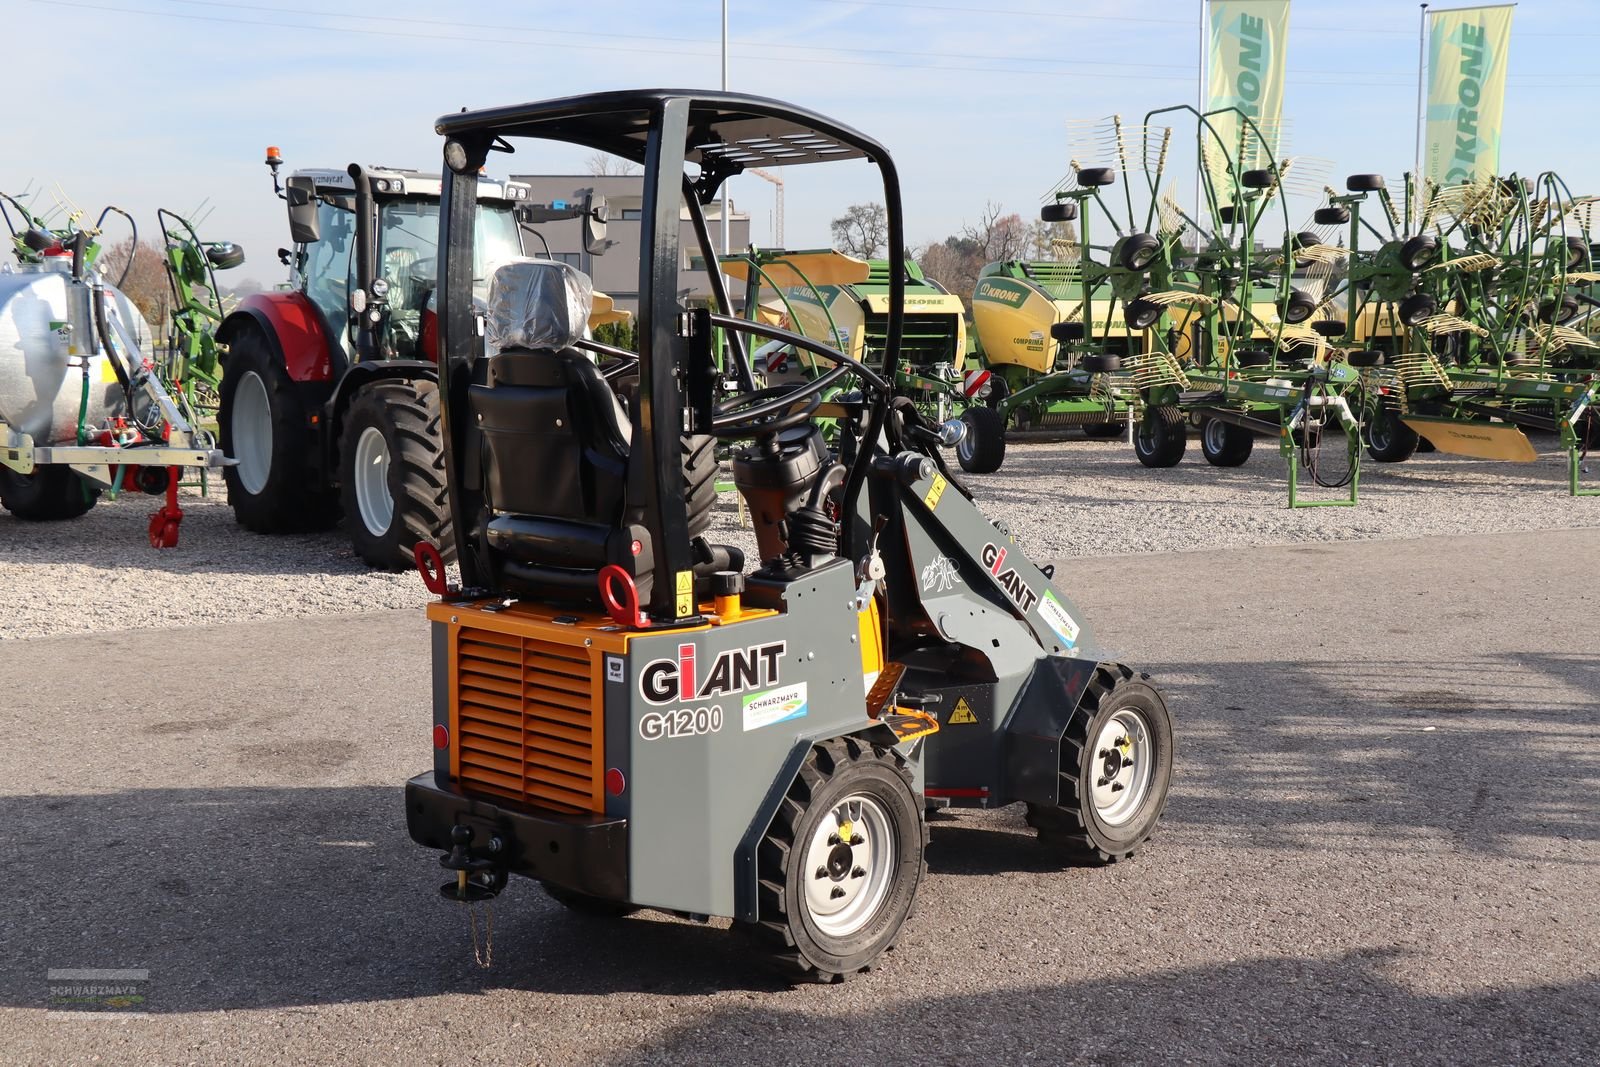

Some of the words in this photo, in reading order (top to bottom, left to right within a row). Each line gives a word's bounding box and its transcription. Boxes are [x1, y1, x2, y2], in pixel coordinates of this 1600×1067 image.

[1455, 22, 1485, 164] KRONE
[988, 288, 1021, 302] KRONE
[1013, 337, 1043, 346] COMPRIMA
[749, 692, 798, 711] SCHWARZMAYR
[640, 705, 722, 740] G1200
